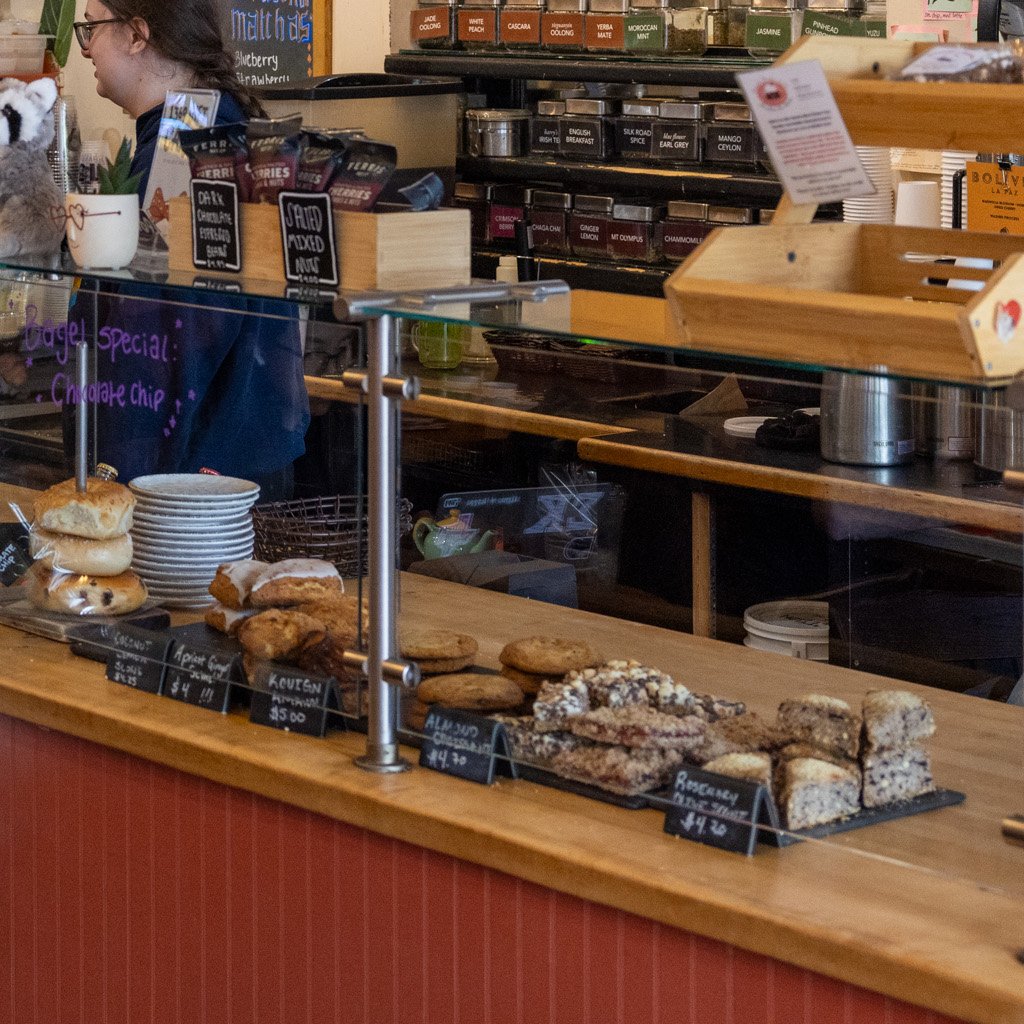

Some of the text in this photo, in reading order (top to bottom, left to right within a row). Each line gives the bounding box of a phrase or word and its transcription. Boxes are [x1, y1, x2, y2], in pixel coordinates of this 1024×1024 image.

[420, 23, 441, 31] OOLONG
[756, 28, 781, 36] JASMINE
[569, 128, 591, 137] ENGLISH
[624, 128, 633, 136] SILK
[566, 136, 594, 145] BREAKFAST
[718, 135, 742, 143] MANGO
[674, 141, 689, 149] GREY
[718, 143, 741, 152] CEYLON
[580, 225, 600, 233] GINGER
[580, 232, 598, 241] LEMON
[620, 234, 643, 242] OLYMPUS
[288, 234, 324, 253] MIXED
